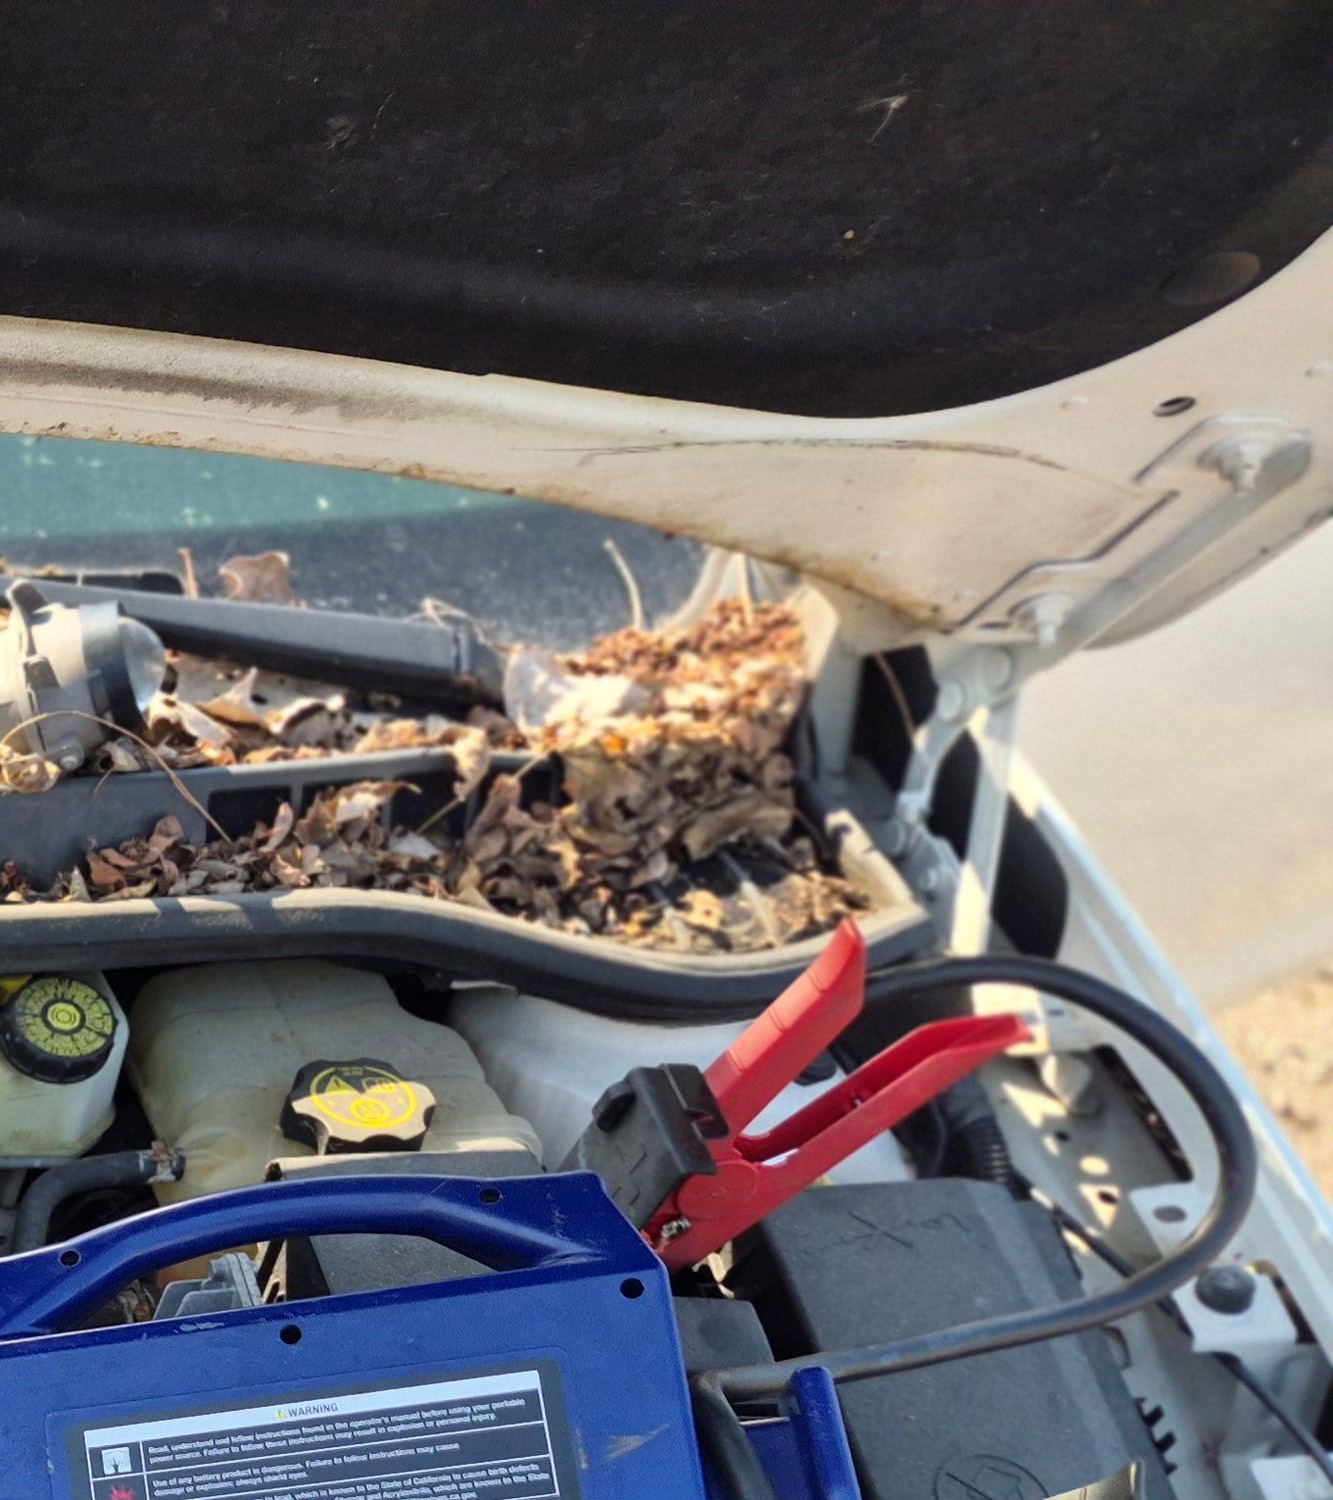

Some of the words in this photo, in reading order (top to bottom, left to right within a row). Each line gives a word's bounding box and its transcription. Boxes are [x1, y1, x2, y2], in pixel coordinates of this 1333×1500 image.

[171, 1439, 213, 1450] understand
[255, 1429, 301, 1440] instructions
[301, 1424, 324, 1433] found
[349, 1416, 389, 1427] operator's
[391, 1411, 420, 1421] manual
[421, 1409, 447, 1418] before
[448, 1406, 471, 1414] using
[472, 1404, 489, 1412] your
[491, 1399, 525, 1410] portable
[288, 1403, 337, 1416] WARNING
[149, 1455, 173, 1464] power
[203, 1448, 229, 1456] Failure
[288, 1434, 333, 1445] instructions
[353, 1427, 376, 1436] result
[387, 1422, 424, 1432] explosion
[436, 1415, 470, 1426] personal
[193, 1473, 220, 1482] battery
[222, 1469, 251, 1479] product
[305, 1459, 332, 1467] Failure
[369, 1449, 415, 1459] instructions
[435, 1443, 459, 1451] cause
[294, 1491, 319, 1499] which
[328, 1487, 355, 1495] known
[413, 1475, 451, 1484] California
[462, 1470, 487, 1478] cause
[488, 1467, 507, 1475] birth
[508, 1464, 539, 1473] defects
